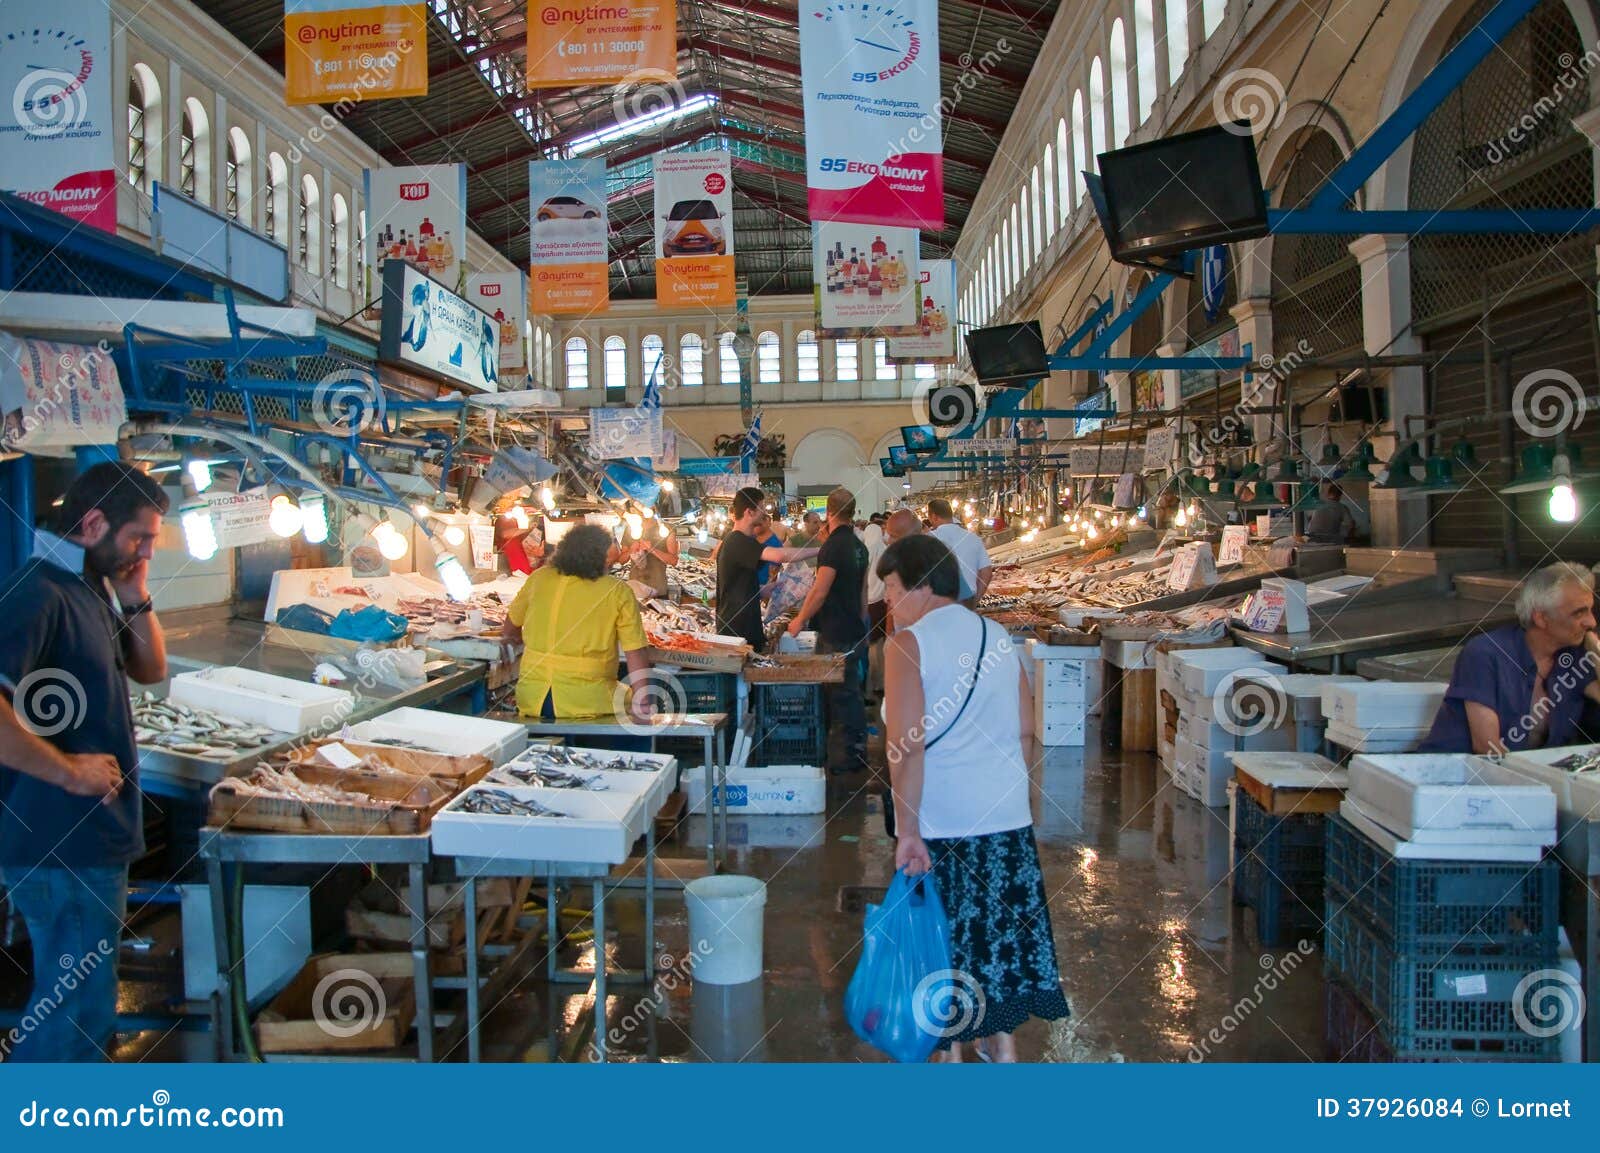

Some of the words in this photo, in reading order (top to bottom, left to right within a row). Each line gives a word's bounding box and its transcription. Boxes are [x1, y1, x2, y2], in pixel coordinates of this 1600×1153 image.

[541, 5, 629, 25] @nytime
[298, 22, 382, 43] @nytime
[598, 24, 662, 33] INTERAMERICAN
[567, 43, 587, 54] 801
[592, 42, 605, 53] 11
[609, 40, 645, 53] 30000
[819, 158, 928, 181] 95EKONOMY
[14, 187, 102, 204] EKONOMY
[889, 183, 925, 192] unleaded
